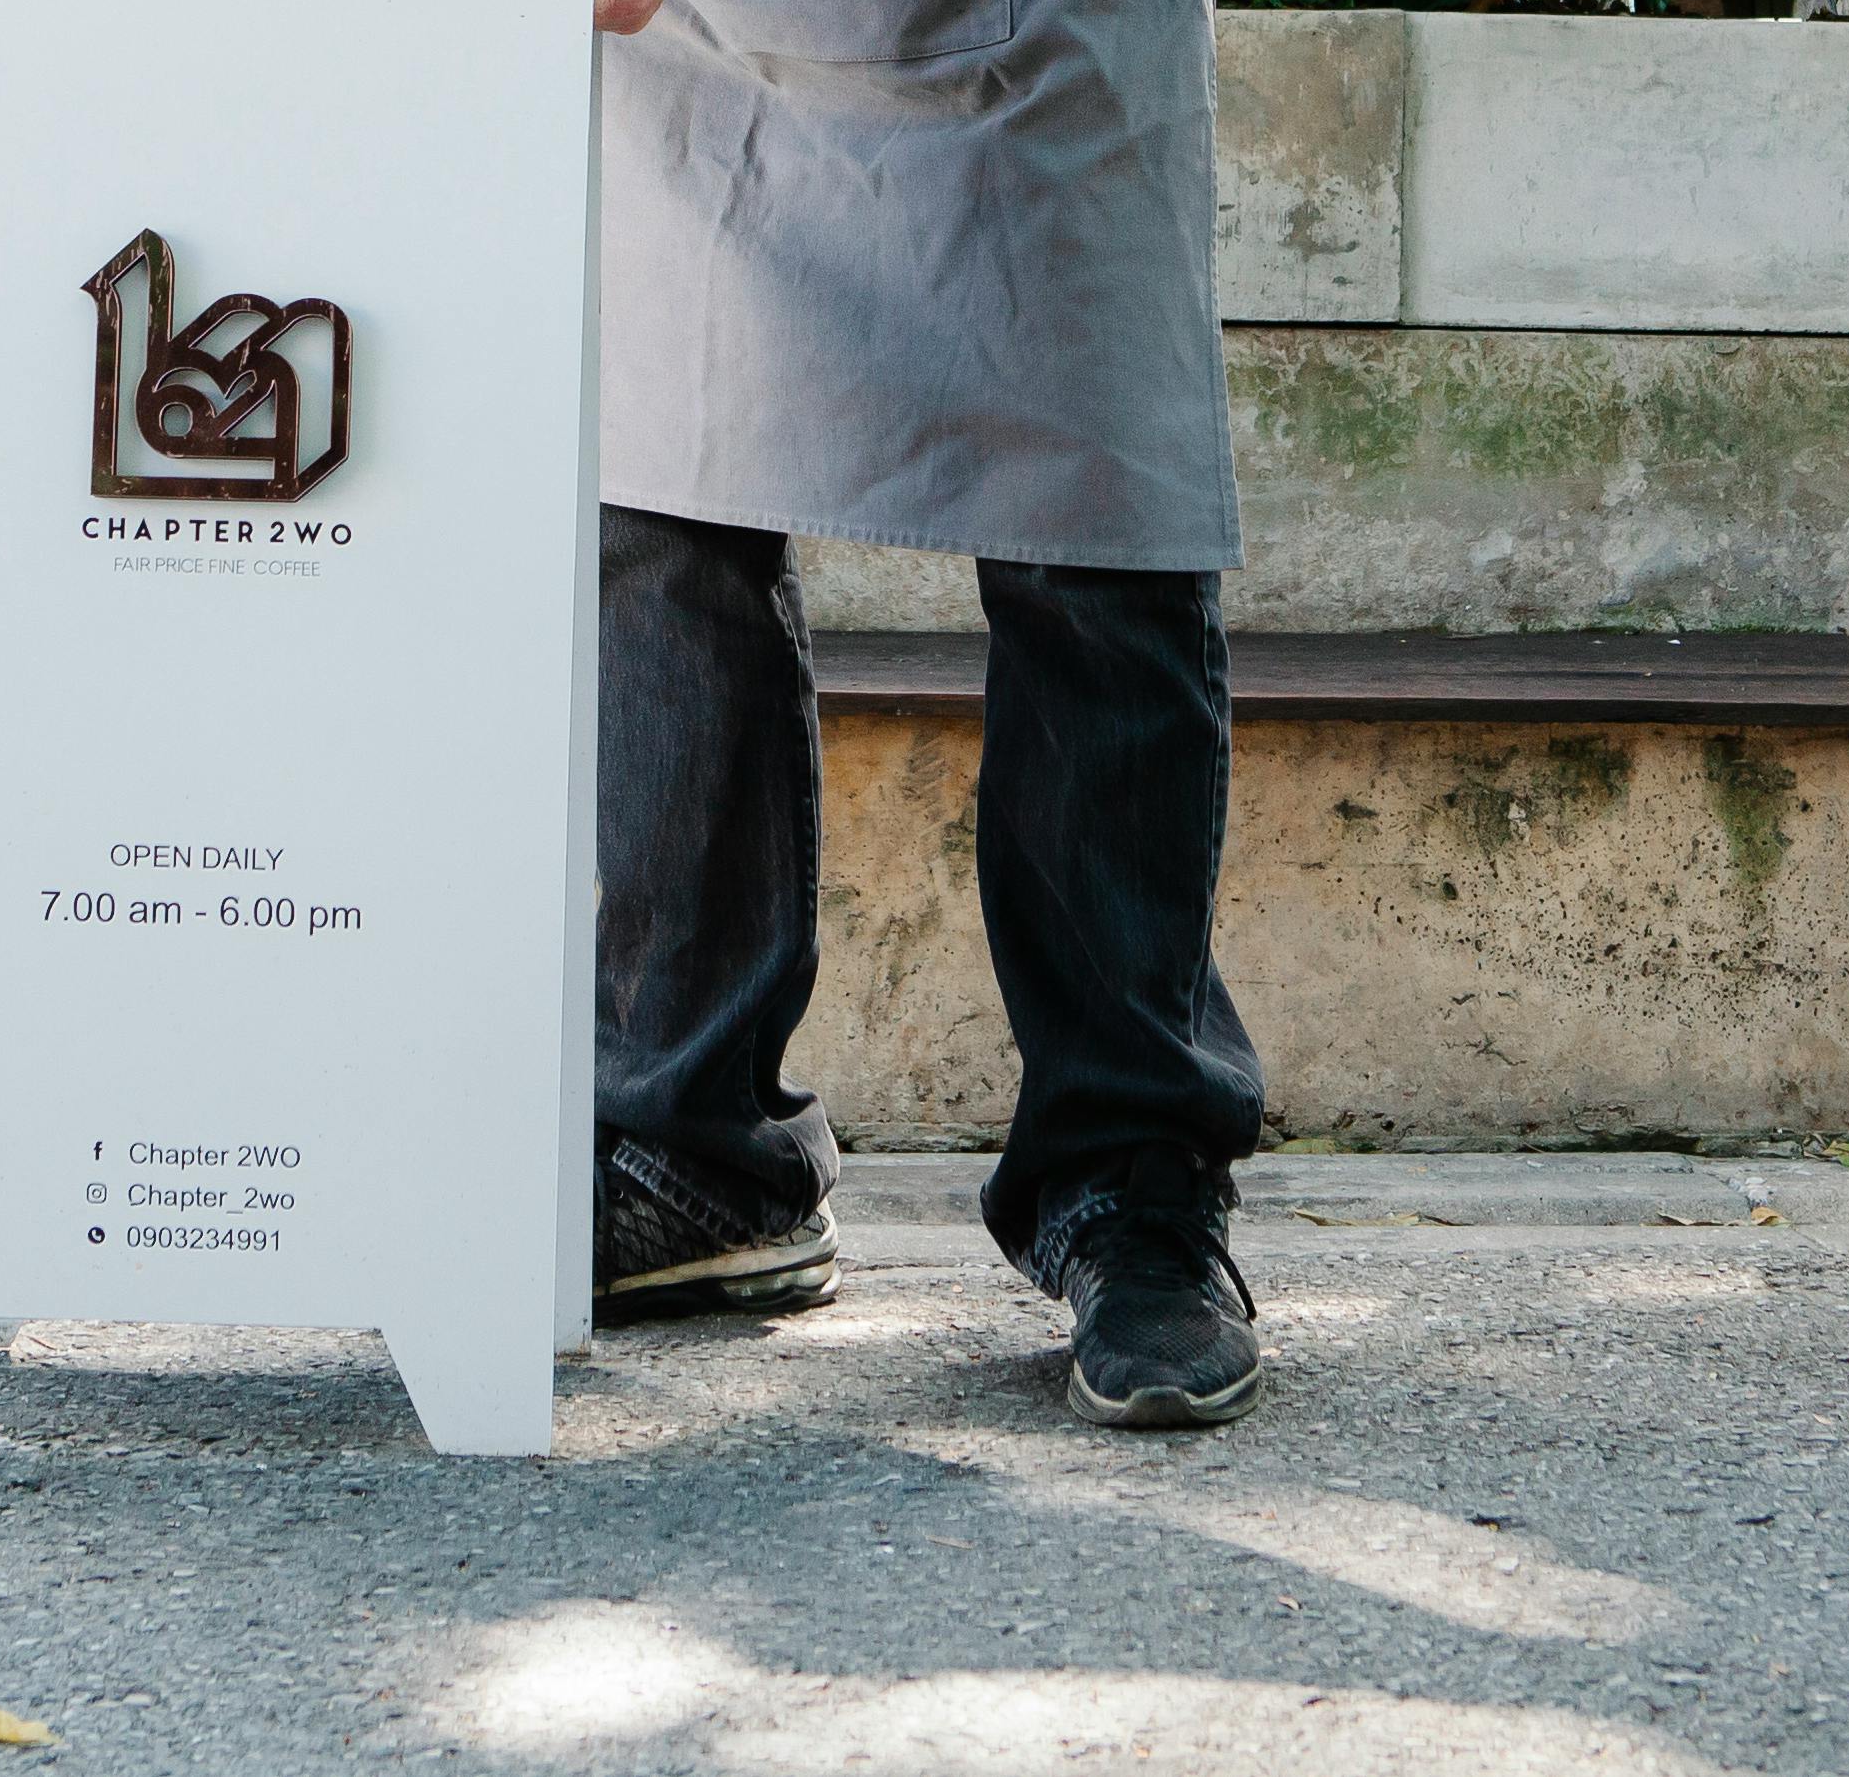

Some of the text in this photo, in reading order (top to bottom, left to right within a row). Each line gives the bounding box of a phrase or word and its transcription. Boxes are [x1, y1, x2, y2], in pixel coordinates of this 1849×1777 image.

[82, 517, 352, 546] CHAPTER 2WO
[113, 556, 321, 577] FAIR PRICE FINE COFFEE
[110, 844, 284, 871] OPEN DAILY
[41, 891, 116, 923] 7.00
[129, 902, 182, 924] am
[219, 896, 296, 928] 6.00
[309, 905, 361, 936] pm
[128, 1142, 229, 1171] Chapter
[237, 1145, 301, 1169] 2WO
[127, 1184, 295, 1214] Chapter_2wo
[126, 1226, 280, 1252] 0903234991
